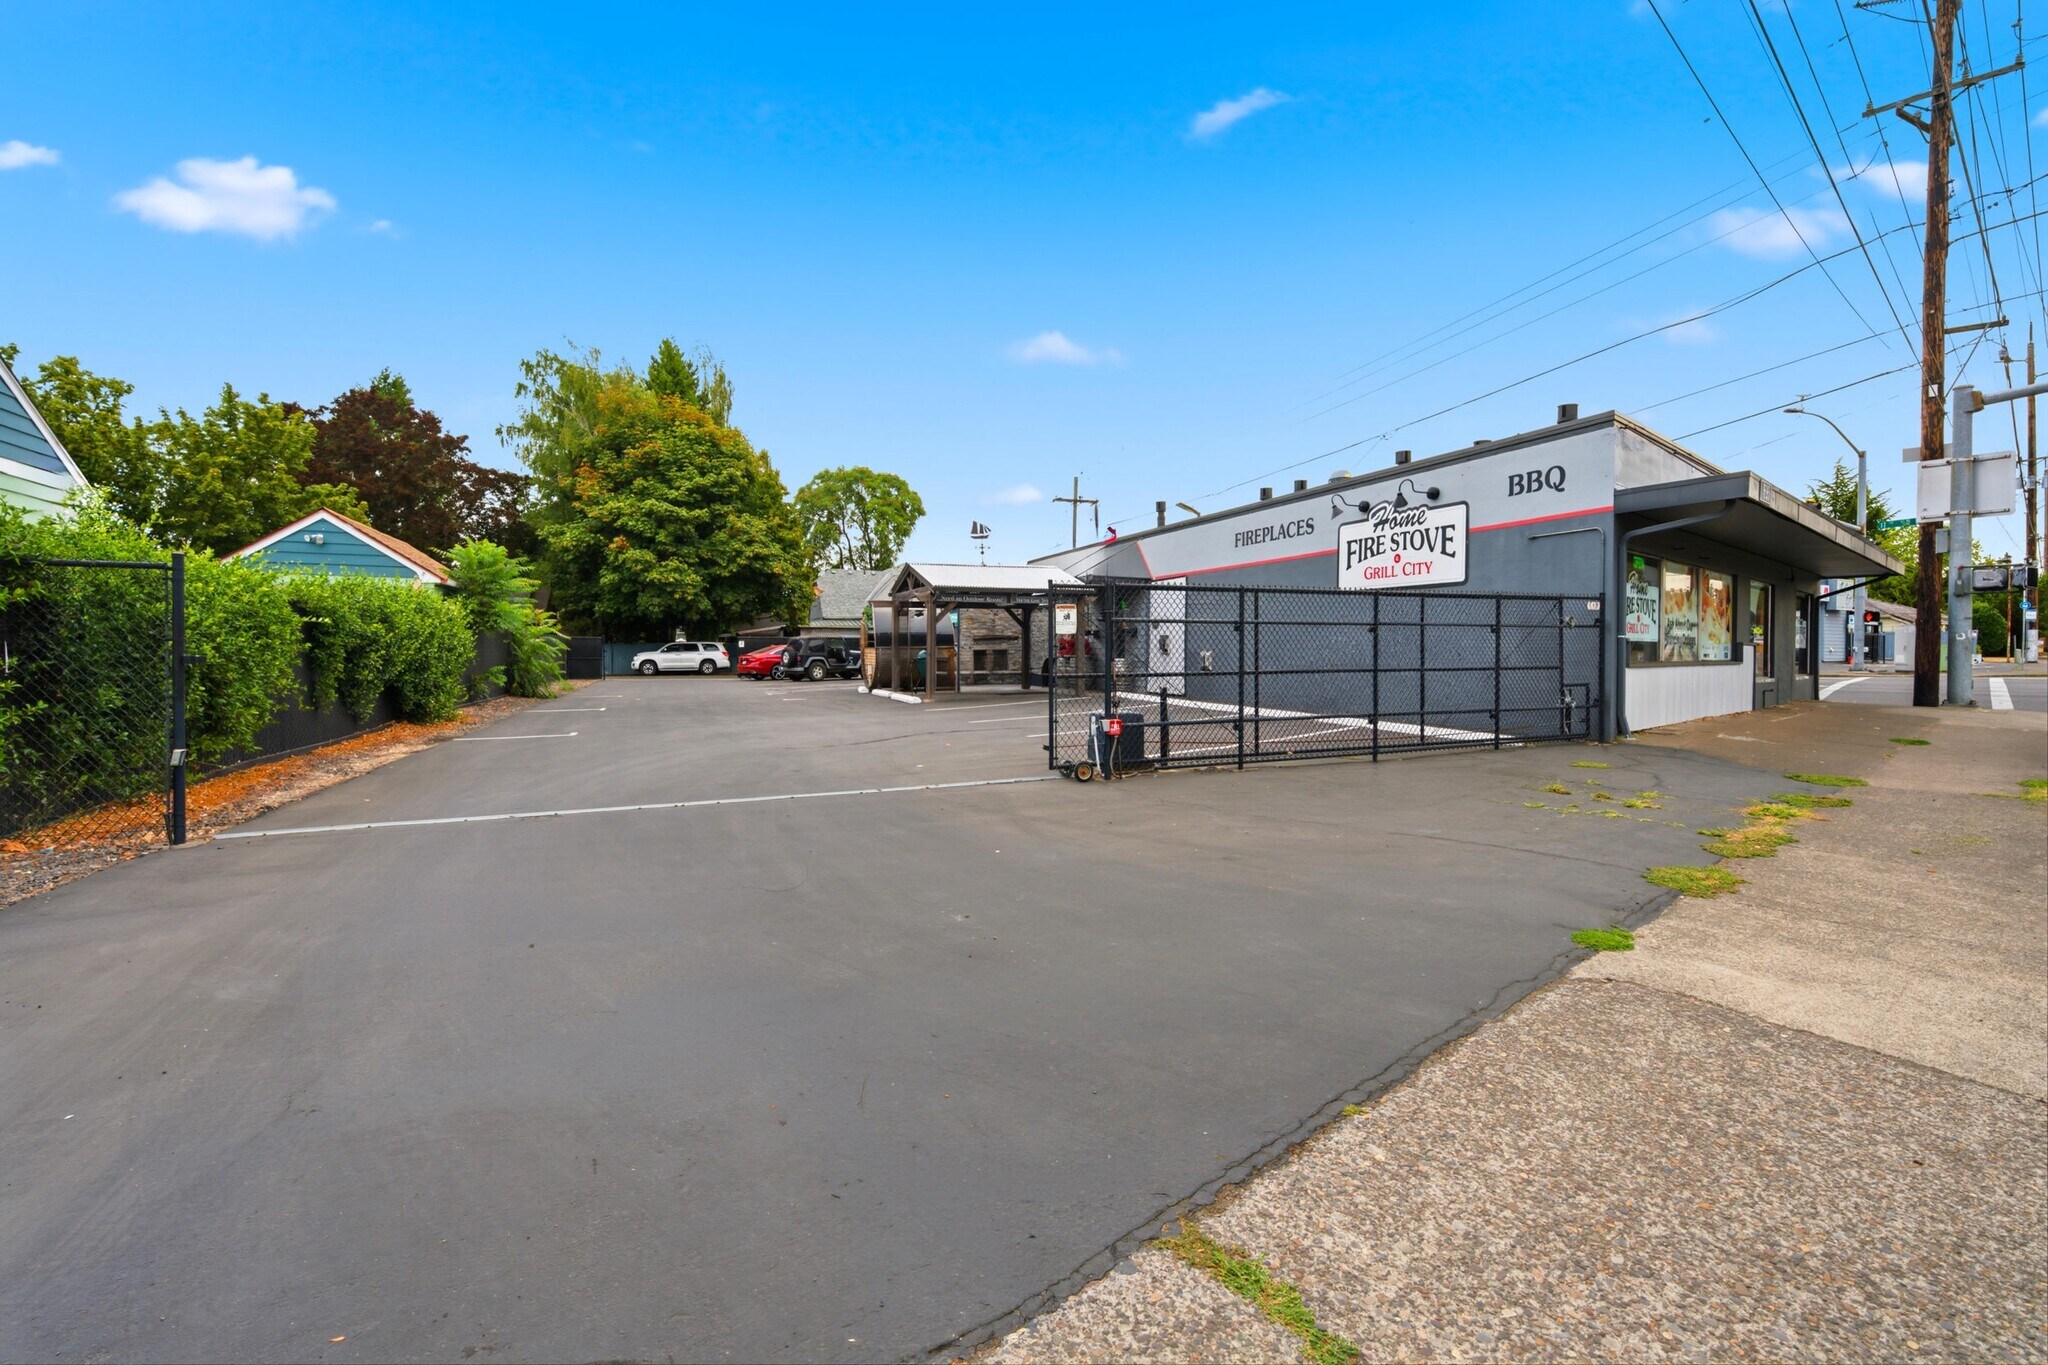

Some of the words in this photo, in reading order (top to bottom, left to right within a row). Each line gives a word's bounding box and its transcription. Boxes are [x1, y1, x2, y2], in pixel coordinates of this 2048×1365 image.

[1508, 465, 1566, 497] BBQ
[1234, 517, 1315, 548] FIREPLACES
[1370, 503, 1428, 533] Home
[1346, 534, 1386, 571] FIRE
[1390, 523, 1456, 559] STOVE
[1364, 565, 1398, 580] GRILL
[1402, 561, 1433, 576] CITY
[1636, 598, 1656, 624] STOVE
